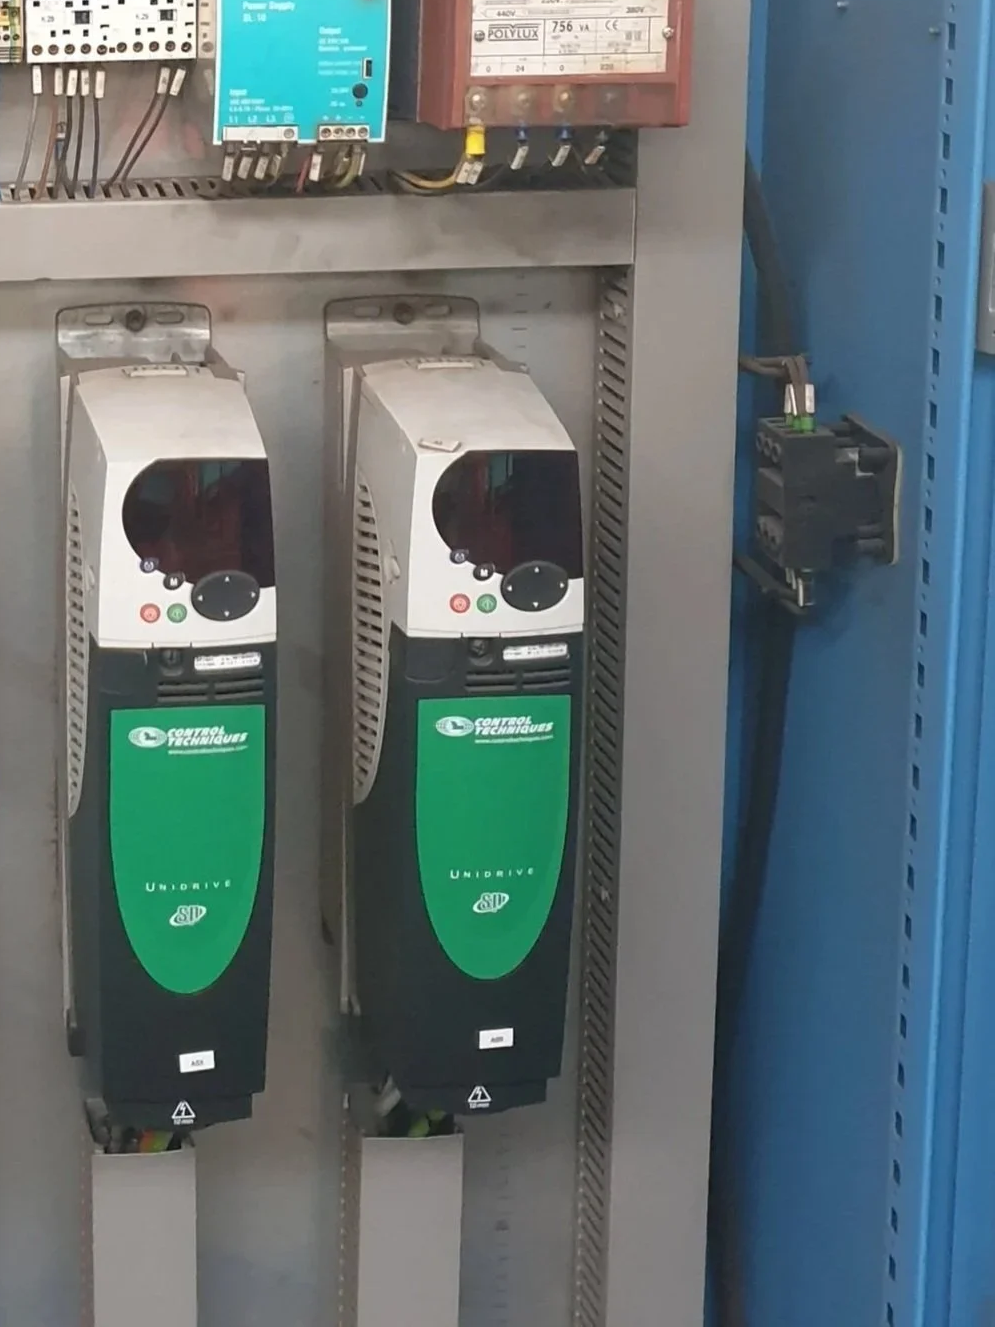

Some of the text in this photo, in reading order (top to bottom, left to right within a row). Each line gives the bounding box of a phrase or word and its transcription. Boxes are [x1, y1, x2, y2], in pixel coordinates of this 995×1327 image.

[242, 1, 296, 12] Power Supply
[552, 21, 590, 32] 756 VA
[488, 27, 539, 39] POLYLUX
[480, 568, 489, 577] M
[170, 577, 178, 586] M
[474, 716, 532, 727] CONTROL
[167, 725, 225, 736] CONTROL
[475, 722, 554, 735] TECHNIQUES
[167, 732, 248, 747] TECHNIQUES
